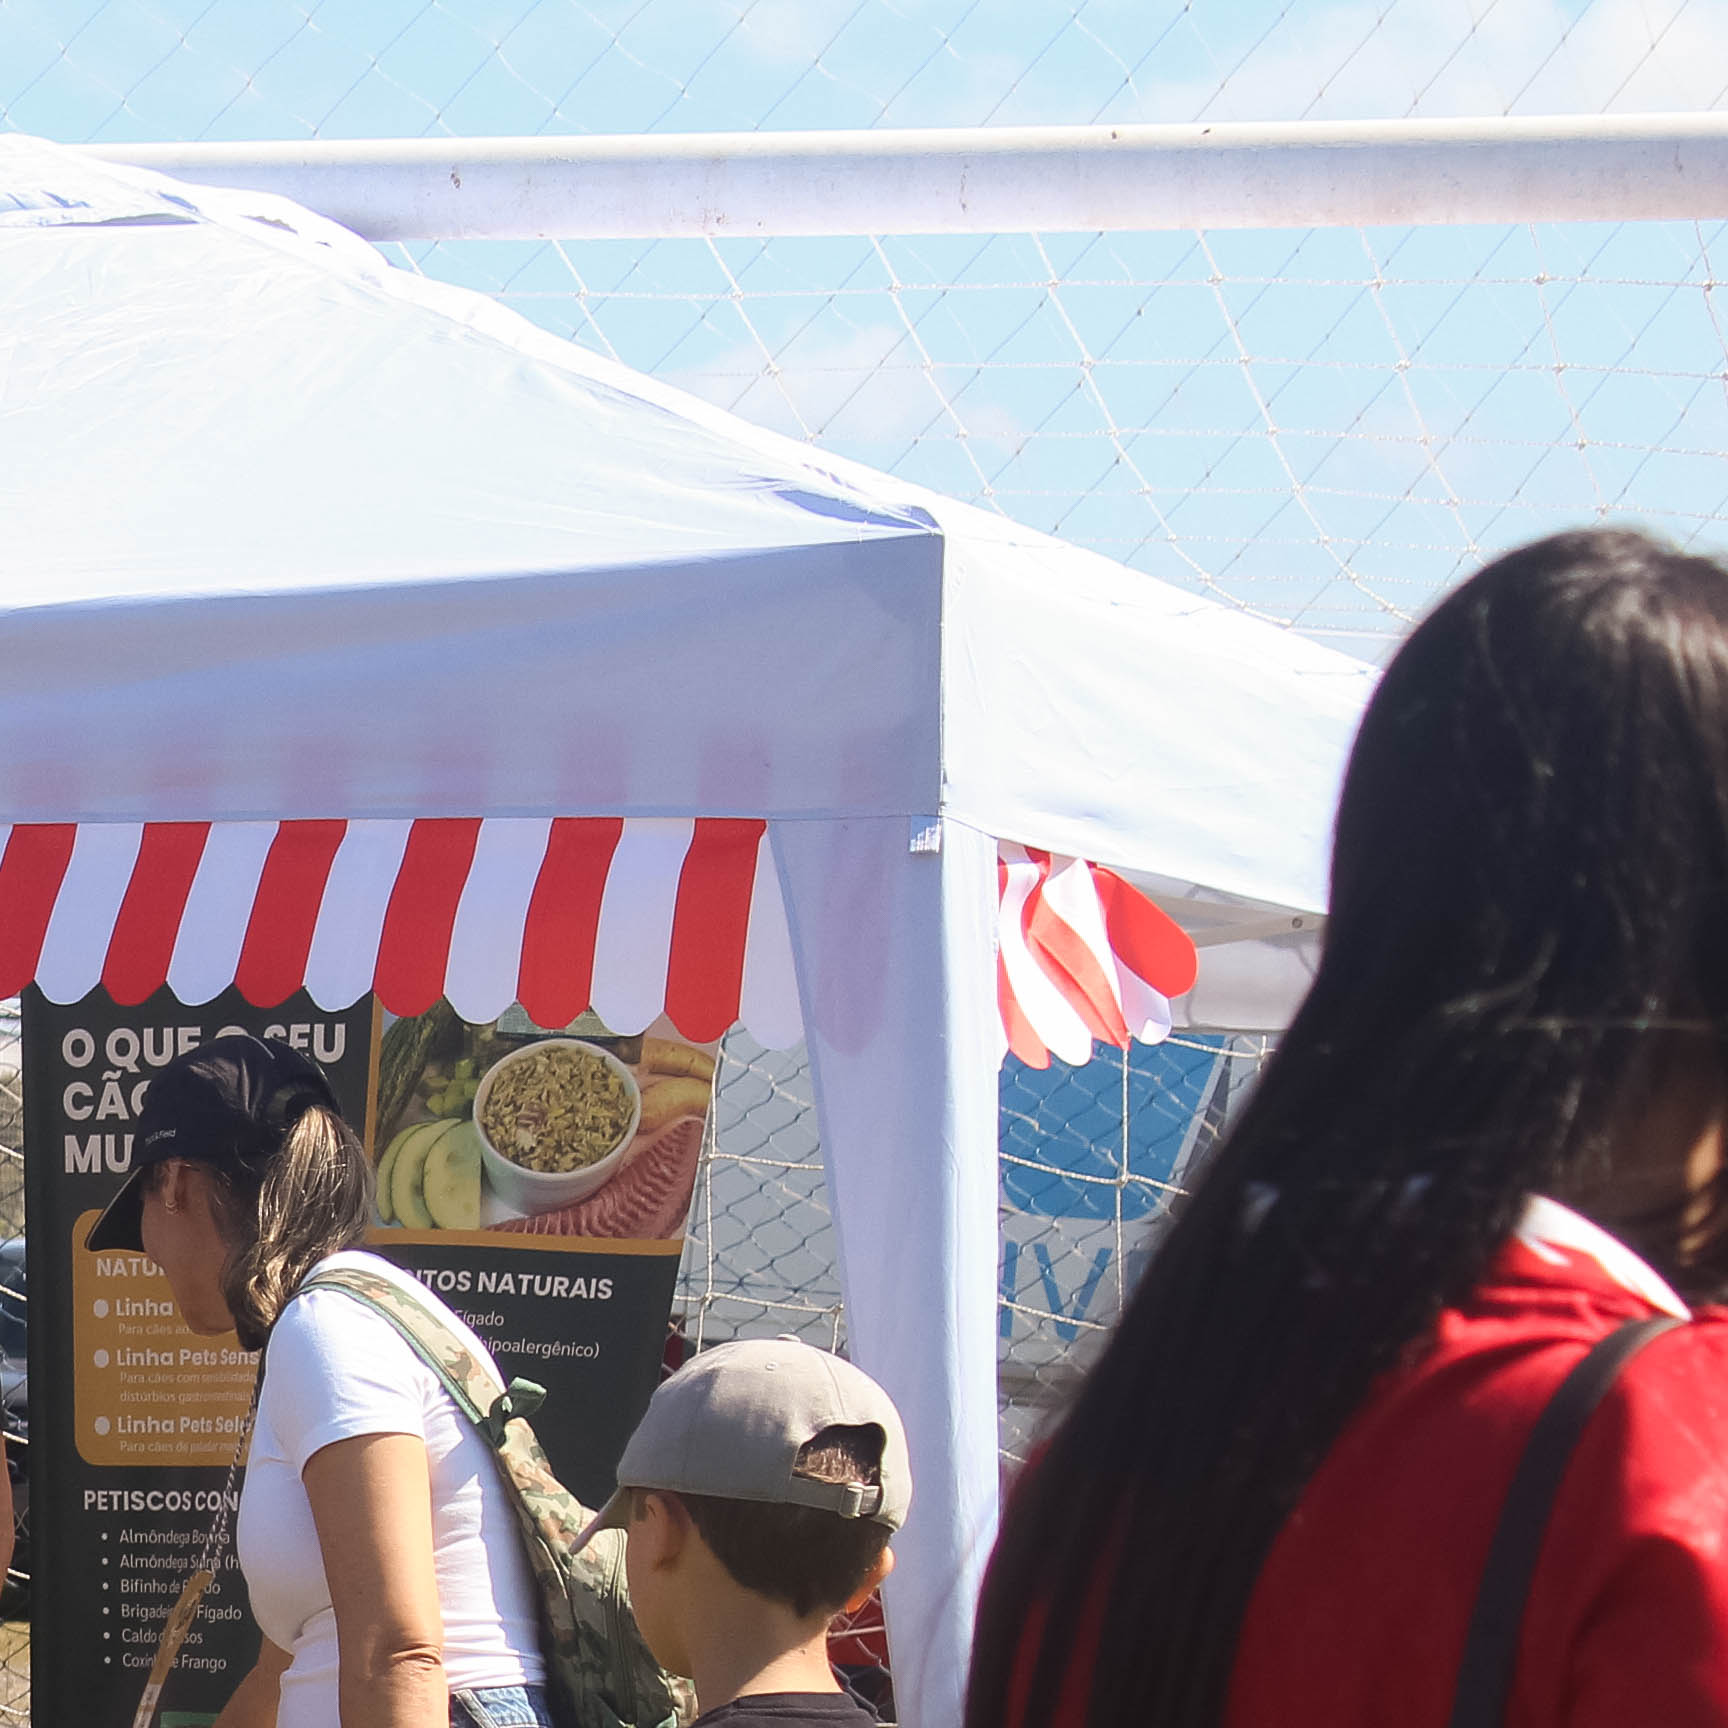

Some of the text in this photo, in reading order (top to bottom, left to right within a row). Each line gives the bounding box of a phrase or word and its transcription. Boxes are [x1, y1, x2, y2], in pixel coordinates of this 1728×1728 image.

[410, 1269, 614, 1300] ITOS NATURAIS
[116, 1298, 174, 1317] Linha
[117, 1347, 174, 1366] Linha
[179, 1348, 217, 1366] Pets
[117, 1415, 175, 1433] Linha
[180, 1416, 213, 1433] Pets
[84, 1490, 191, 1512] PETISCOS
[120, 1578, 167, 1593] Bifinho
[122, 1628, 157, 1643] Caldo
[182, 1654, 227, 1674] Frango
